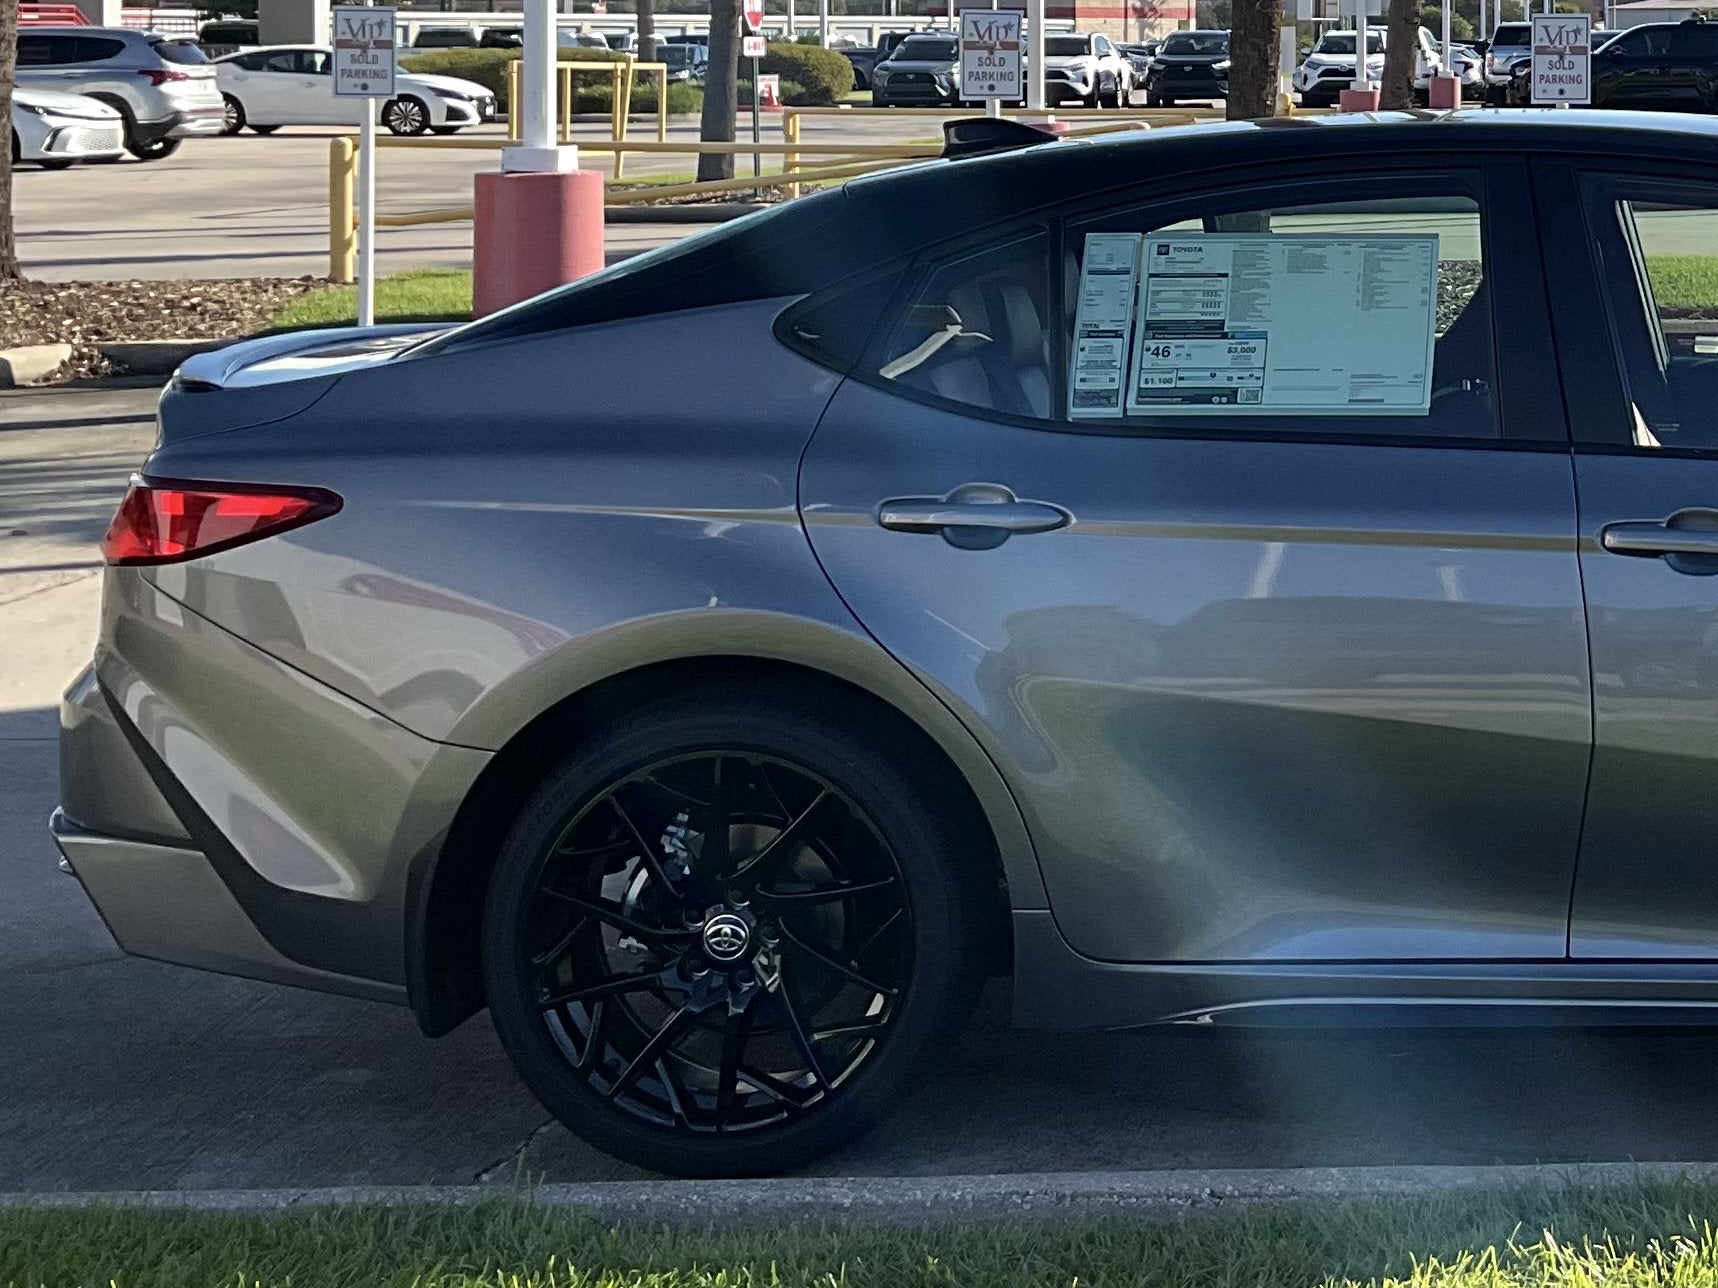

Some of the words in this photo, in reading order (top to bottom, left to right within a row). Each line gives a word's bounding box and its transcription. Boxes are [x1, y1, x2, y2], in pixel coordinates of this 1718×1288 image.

[350, 54, 379, 65] SOLD
[977, 57, 1006, 68] SOLD
[1547, 60, 1575, 71] SOLD
[340, 68, 388, 80] PARKING
[968, 71, 1015, 82] PARKING
[1539, 74, 1583, 85] PARKING
[1150, 345, 1171, 359] 46
